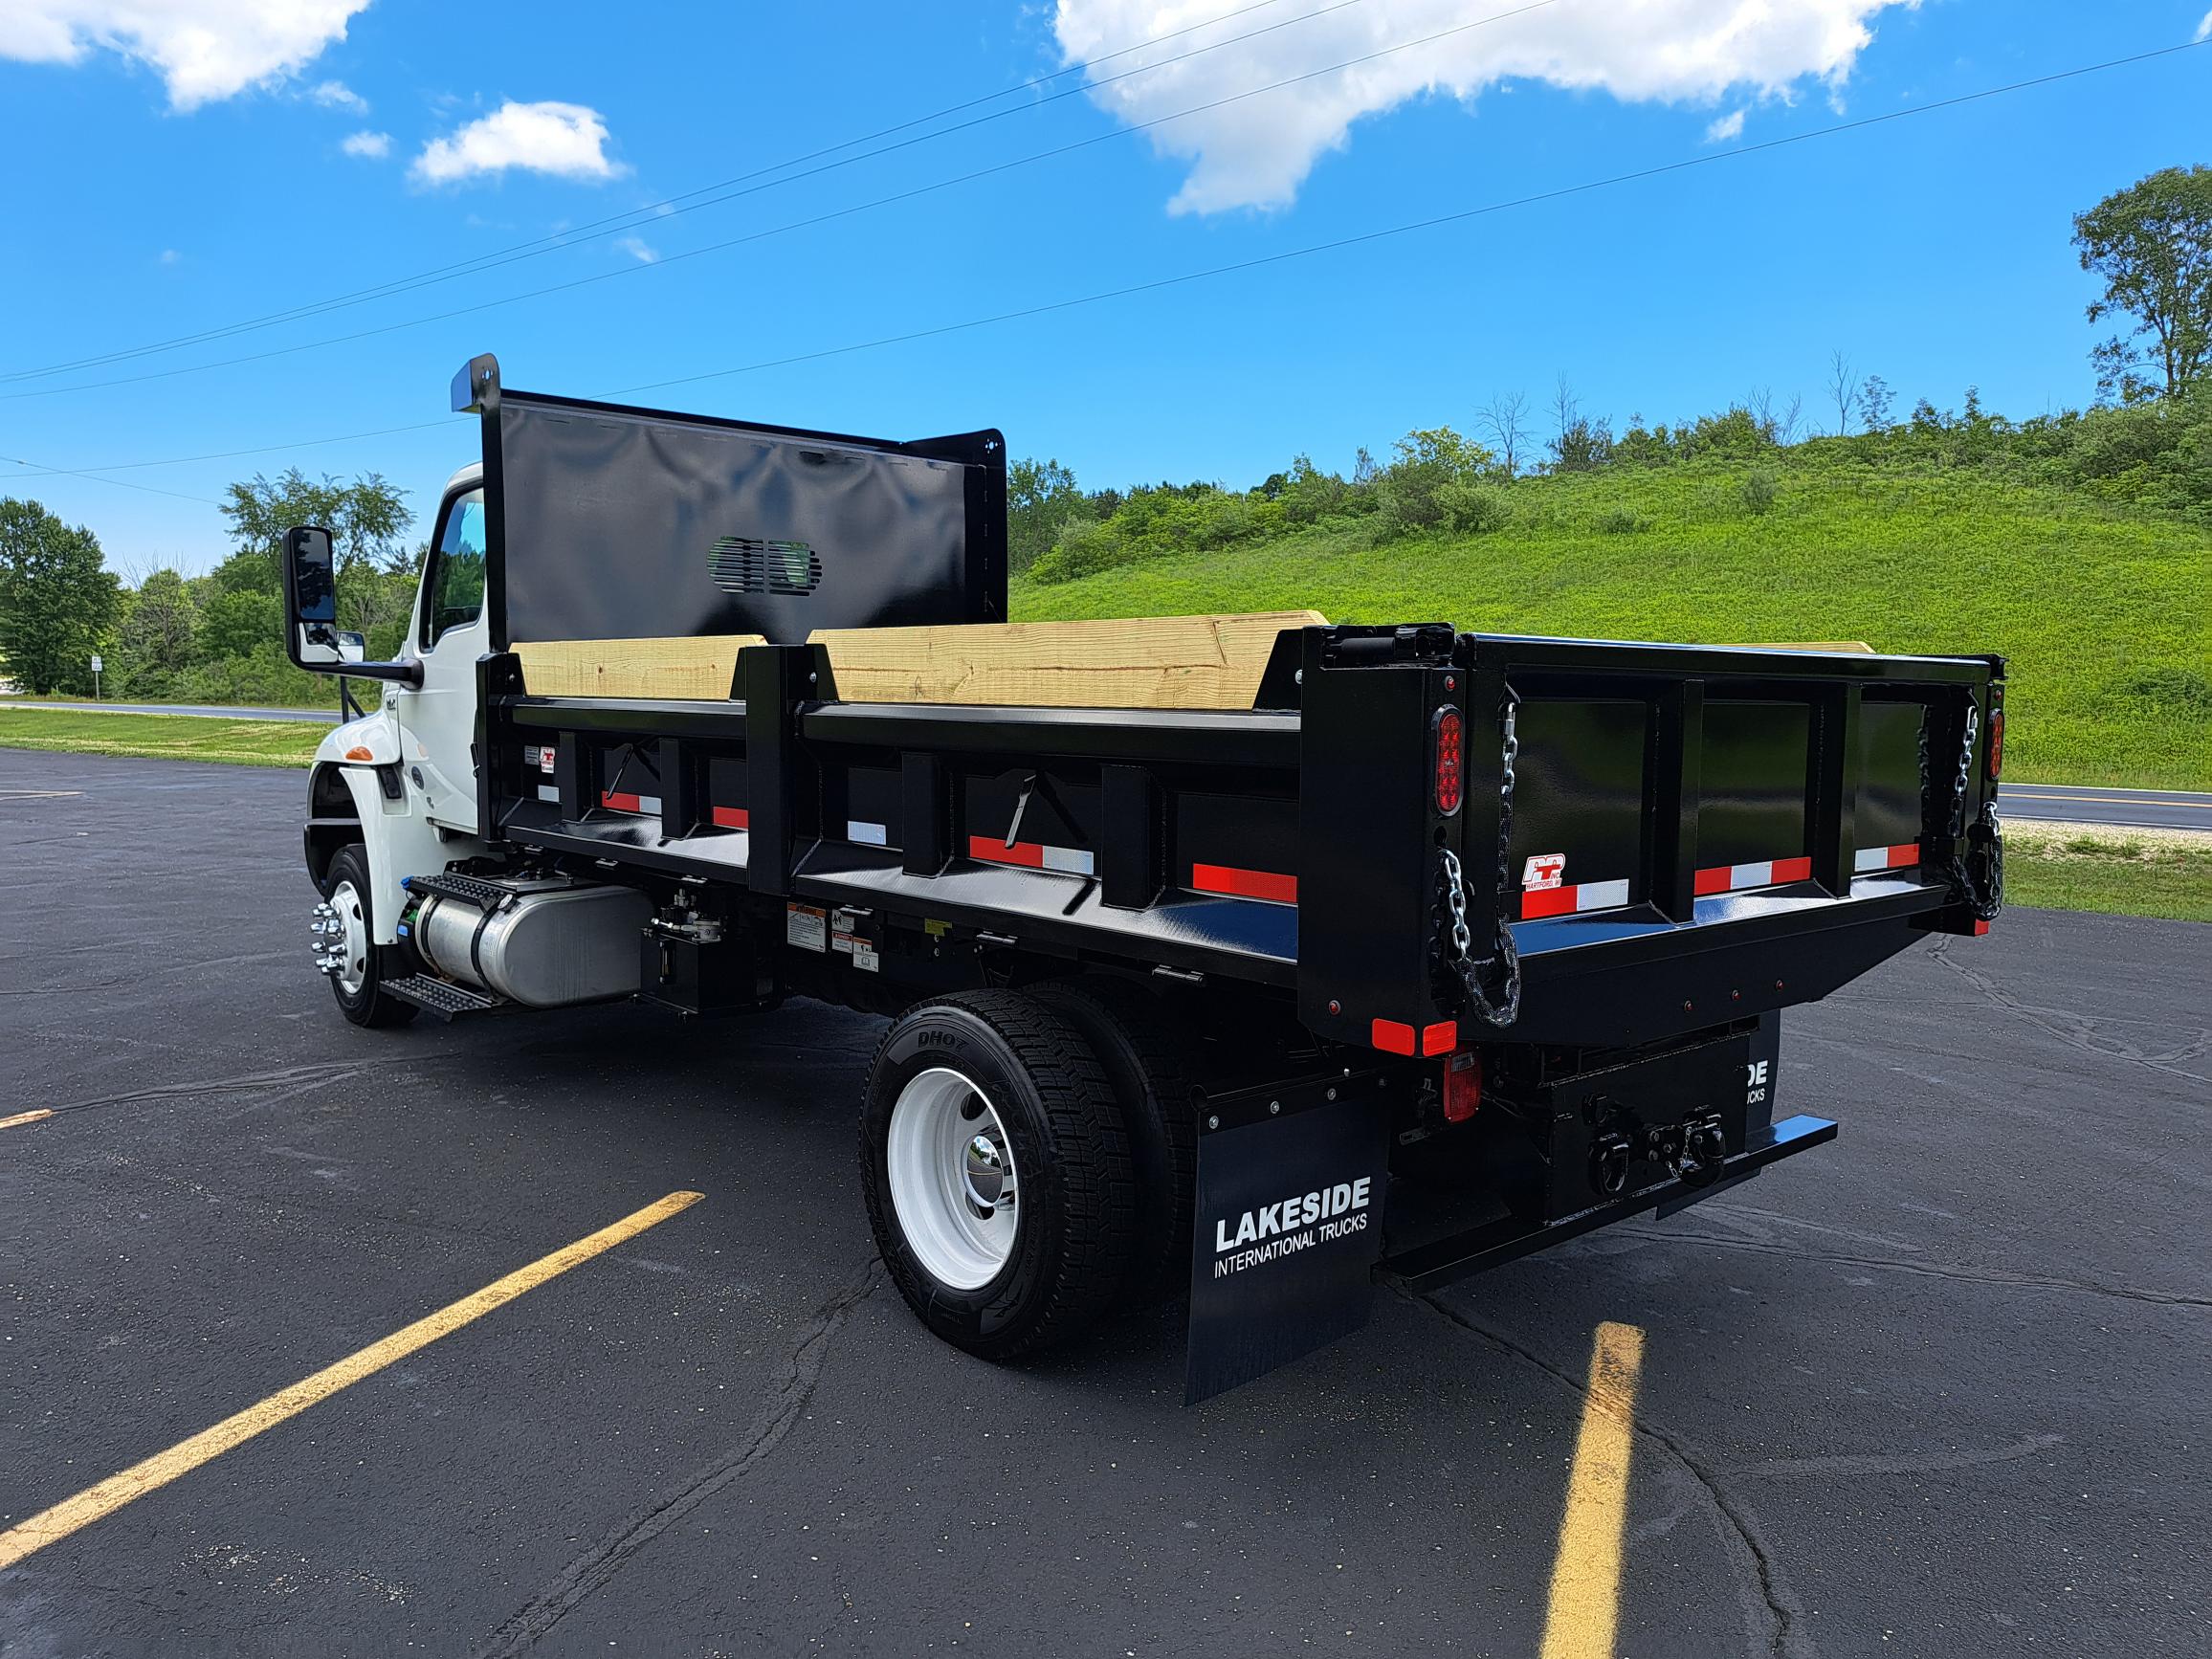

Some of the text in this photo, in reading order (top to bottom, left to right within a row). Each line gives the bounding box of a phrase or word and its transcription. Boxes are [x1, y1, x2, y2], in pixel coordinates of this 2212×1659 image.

[1214, 1213, 1367, 1279] INTERNATIONAL TRUCKS
[1216, 1176, 1371, 1252] LAKESIDE
